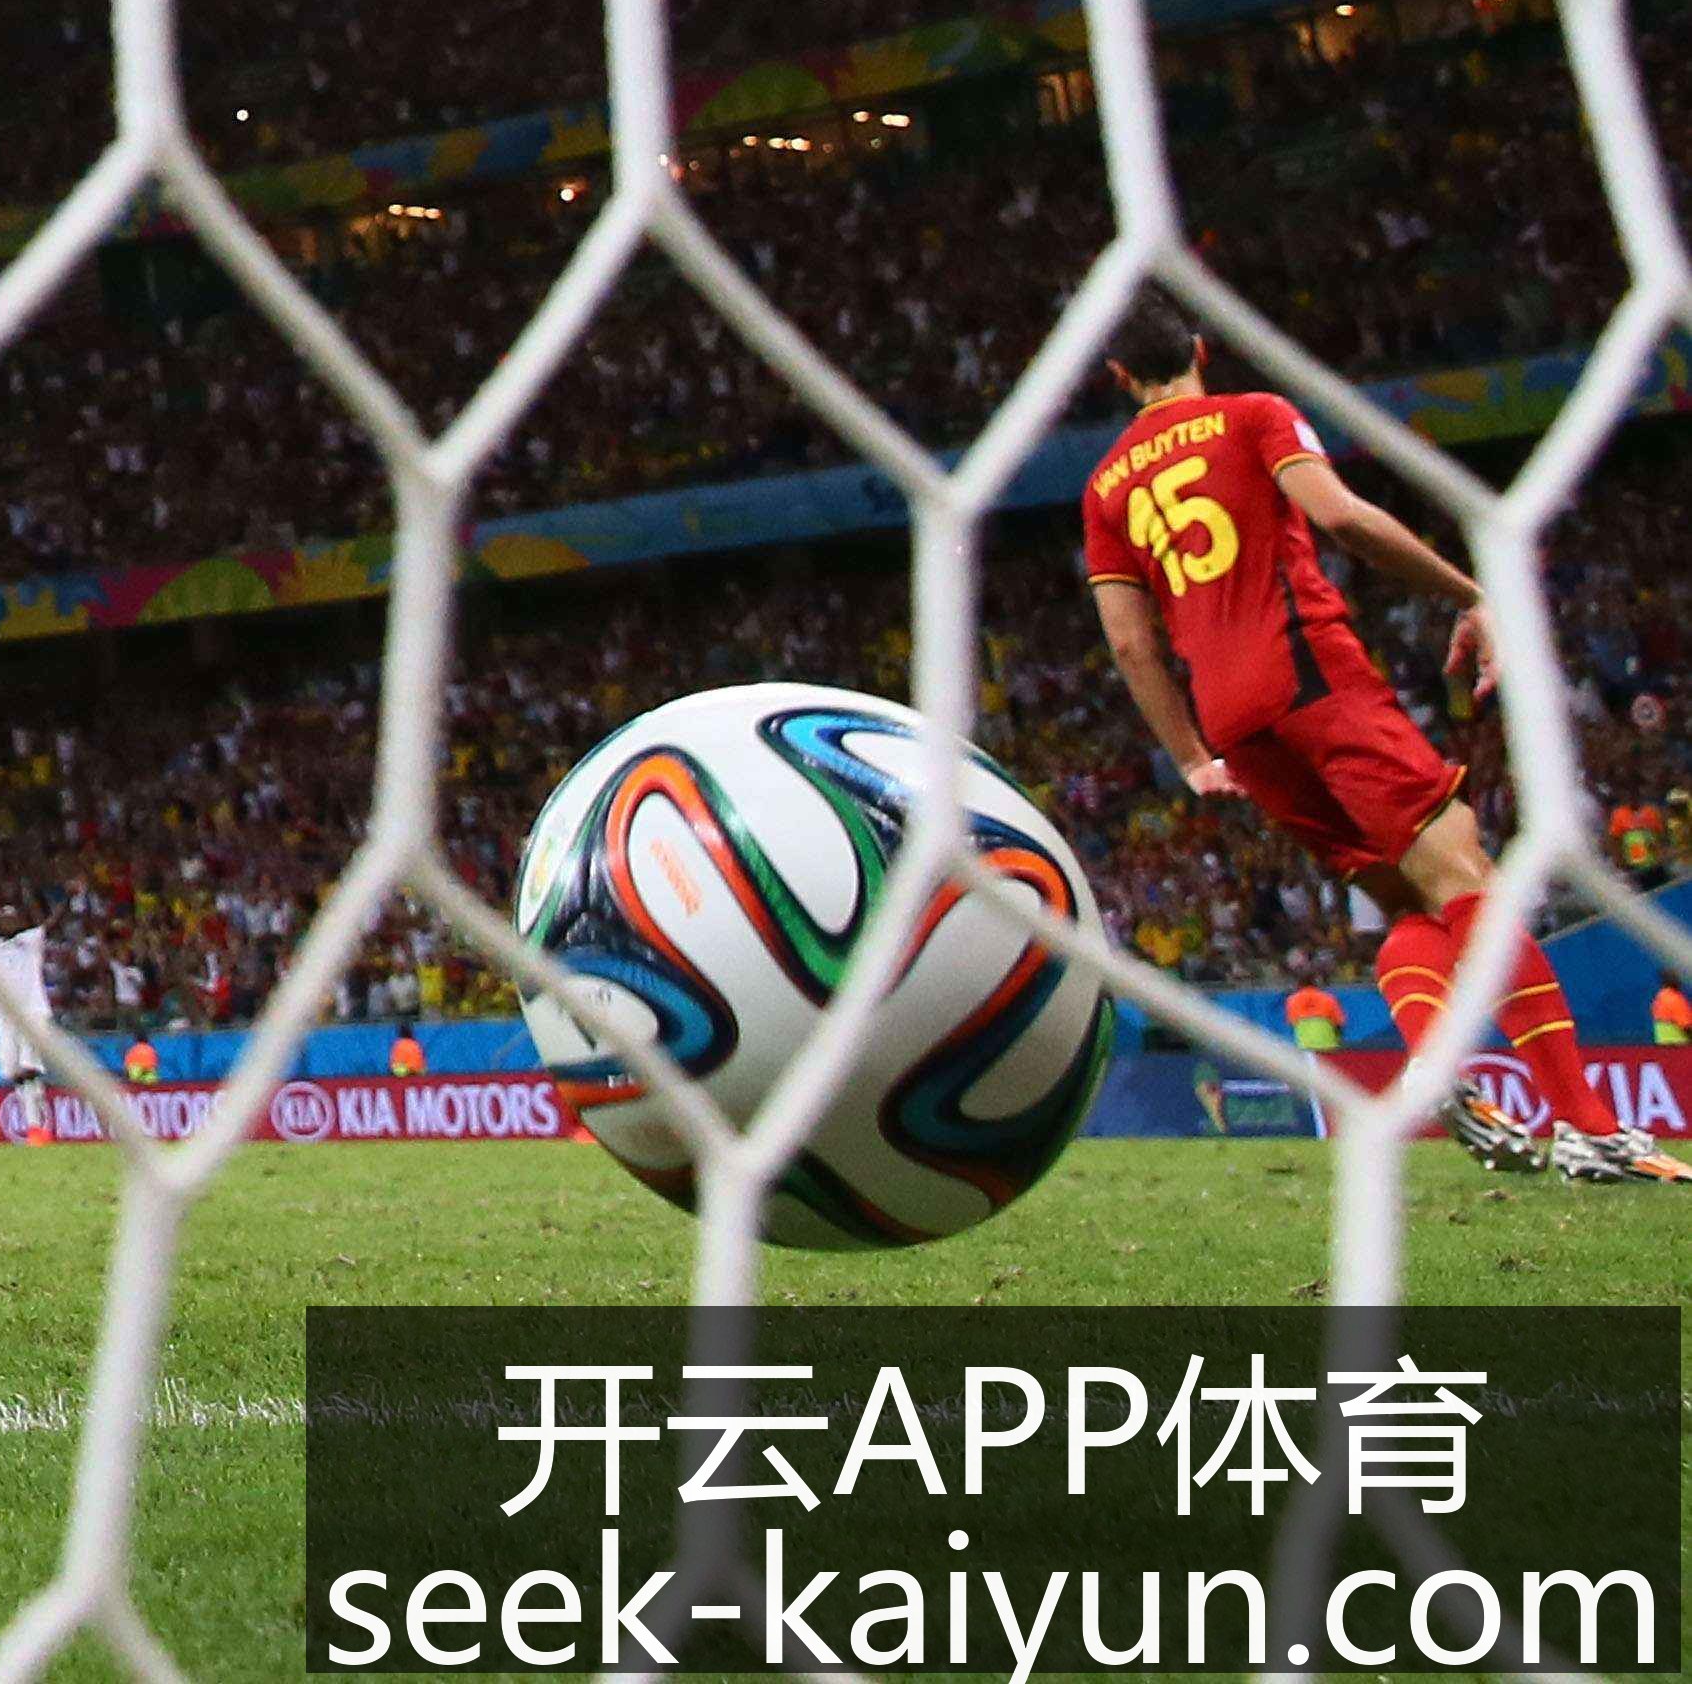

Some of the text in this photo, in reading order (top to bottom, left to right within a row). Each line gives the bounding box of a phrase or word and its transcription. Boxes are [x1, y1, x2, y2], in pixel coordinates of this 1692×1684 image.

[1129, 411, 1226, 472] BUYTEN
[1127, 455, 1240, 597] 15
[54, 1095, 104, 1139] KIA
[336, 1086, 400, 1137] KIA
[404, 1081, 560, 1137] MOTORS
